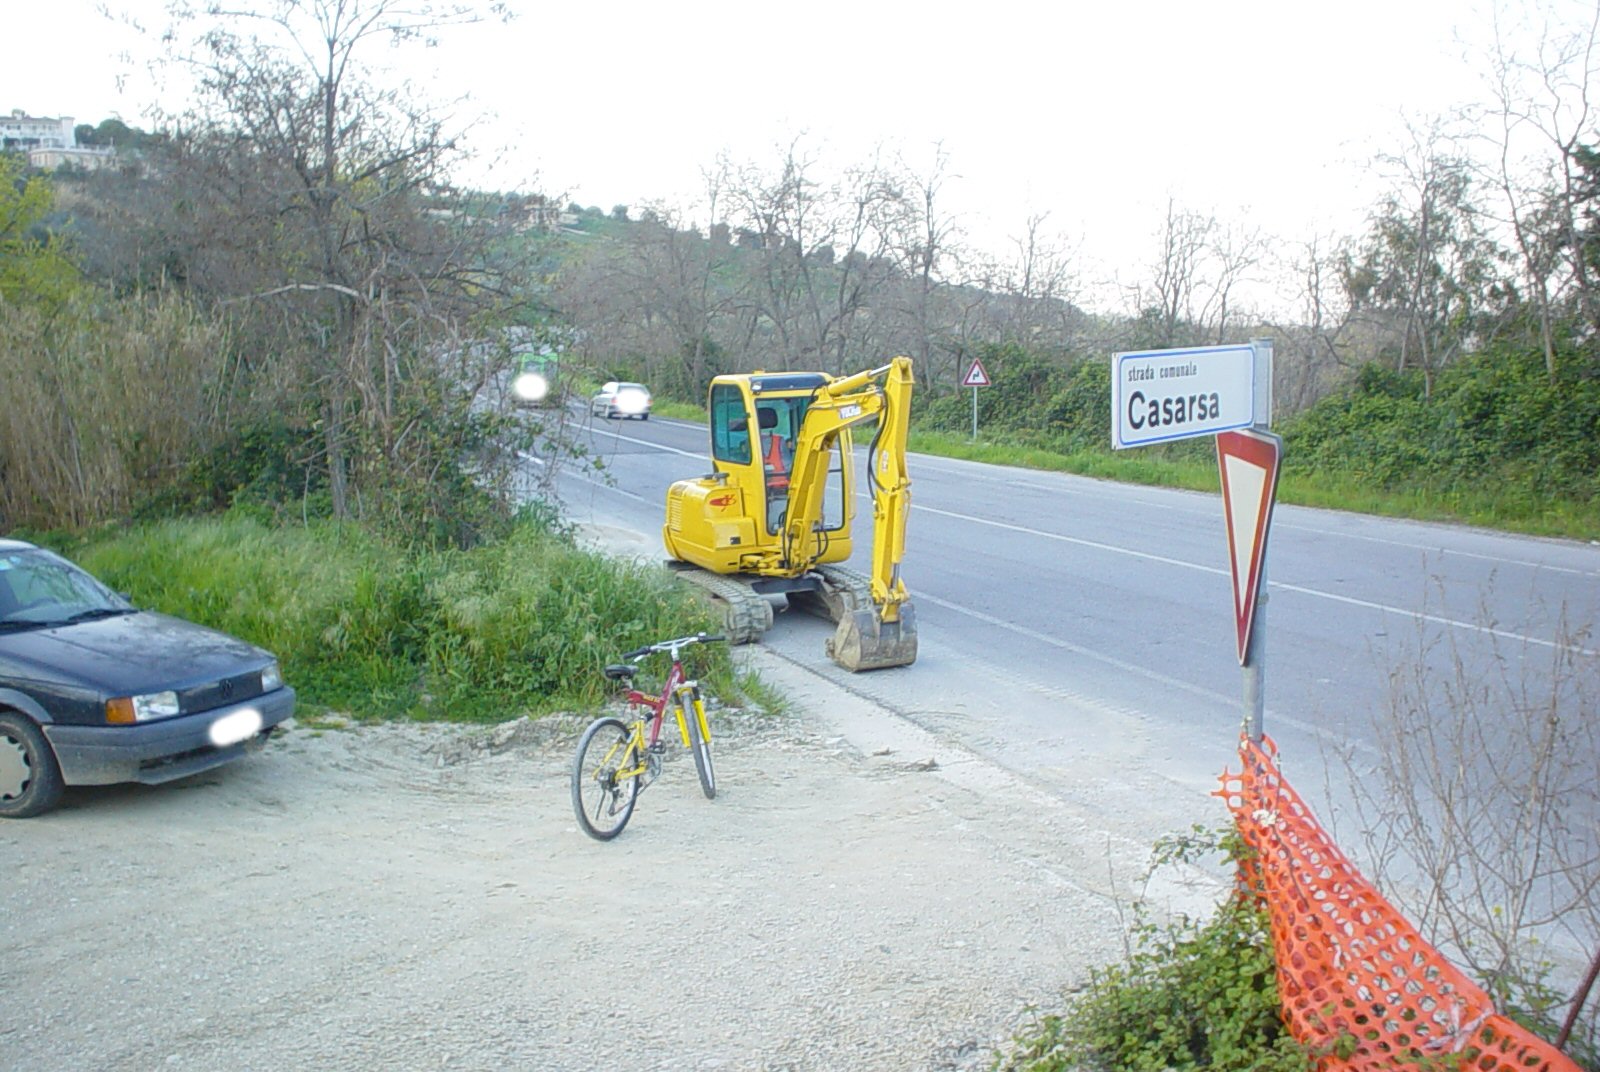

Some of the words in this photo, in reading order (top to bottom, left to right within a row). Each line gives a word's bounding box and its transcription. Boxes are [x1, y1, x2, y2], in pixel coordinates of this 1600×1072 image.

[1128, 364, 1154, 382] strada
[1160, 361, 1197, 378] comunale
[1128, 390, 1220, 430] Casarsa
